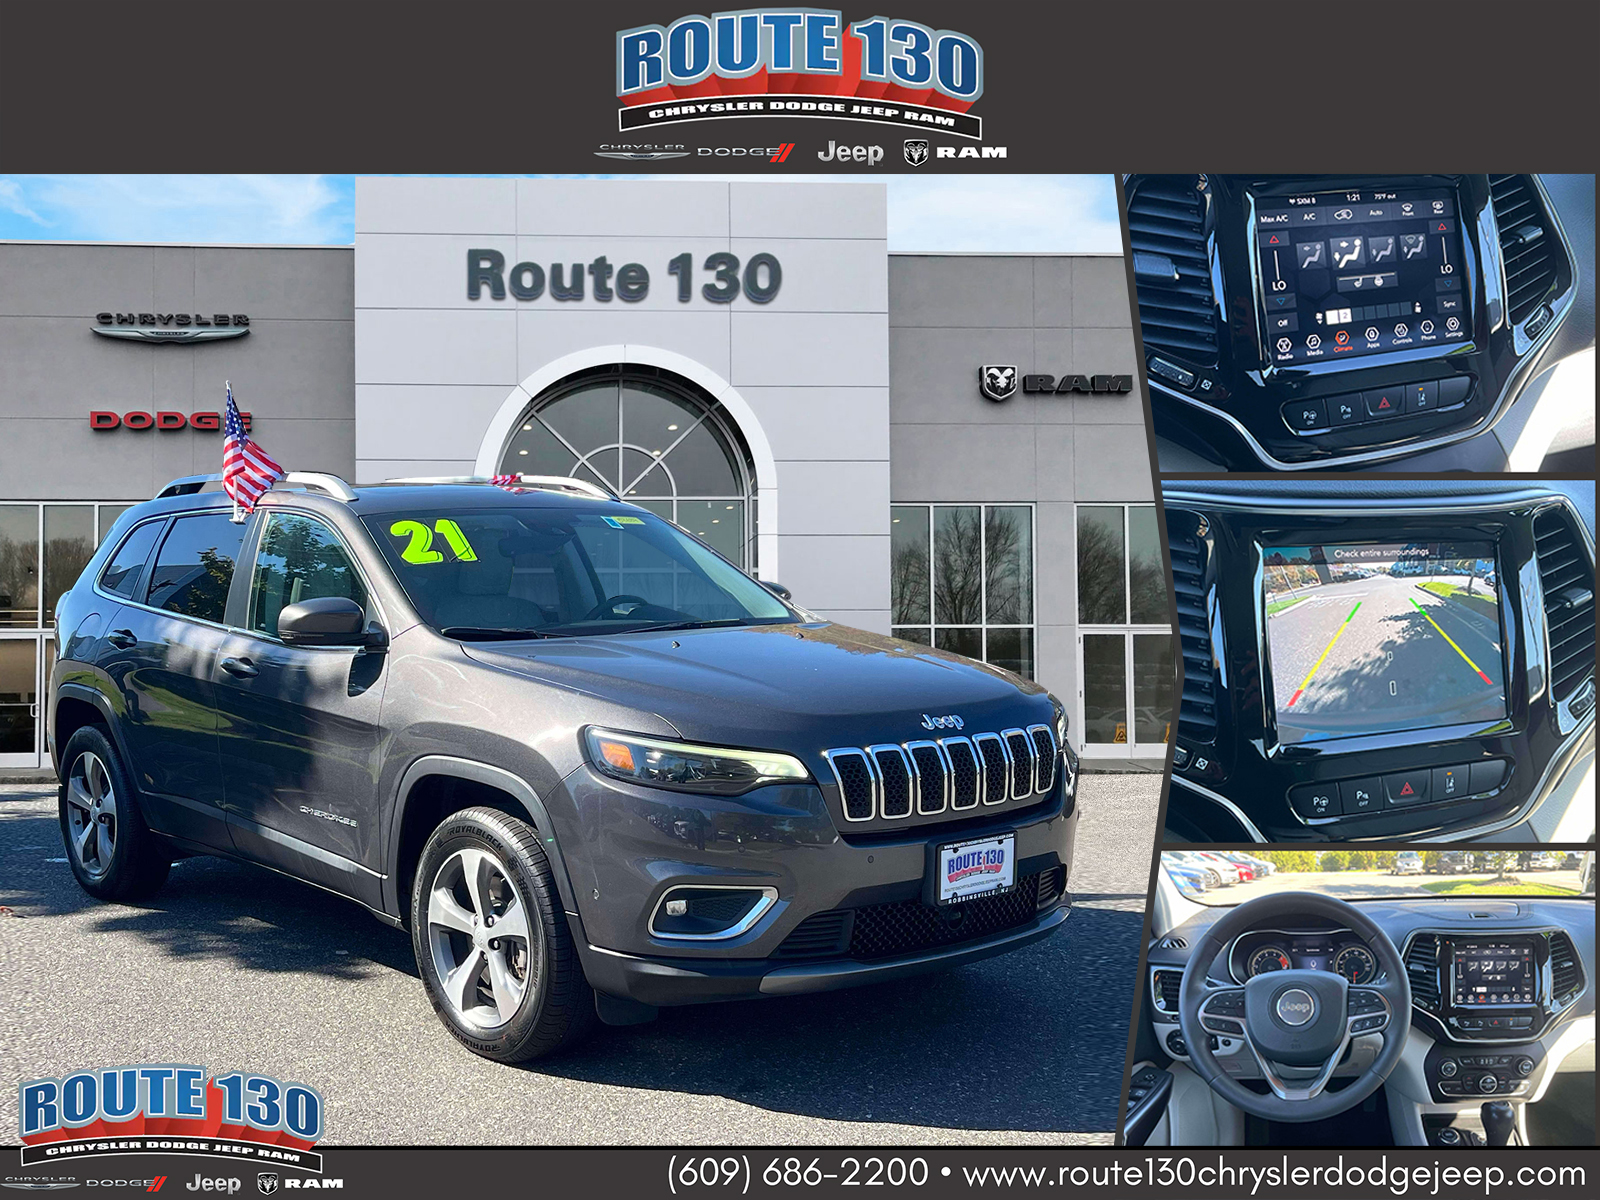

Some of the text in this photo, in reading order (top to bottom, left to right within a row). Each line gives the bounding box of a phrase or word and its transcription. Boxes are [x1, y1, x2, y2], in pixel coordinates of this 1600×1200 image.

[1276, 214, 1288, 222] A/C
[1303, 212, 1316, 221] A/C
[1440, 264, 1453, 274] LO
[467, 248, 782, 303] Route 130
[1272, 280, 1287, 291] LO
[1443, 301, 1456, 309] Sync
[96, 312, 250, 326] CHRYSLER
[1278, 319, 1288, 327] Off
[1445, 330, 1463, 338] Settings
[1366, 341, 1380, 349] Apps
[1277, 353, 1293, 361] Radio
[1307, 349, 1323, 357] Media
[1022, 374, 1133, 395] RAM
[390, 519, 478, 565] 21
[1334, 548, 1429, 559] Check entire surroundings
[921, 714, 964, 730] Jeep
[300, 805, 358, 828] CHEROKEE
[447, 825, 504, 851] ROYALBLACK
[948, 850, 983, 875] ROUTE
[985, 849, 1004, 865] 130
[1281, 1001, 1310, 1013] Jeep
